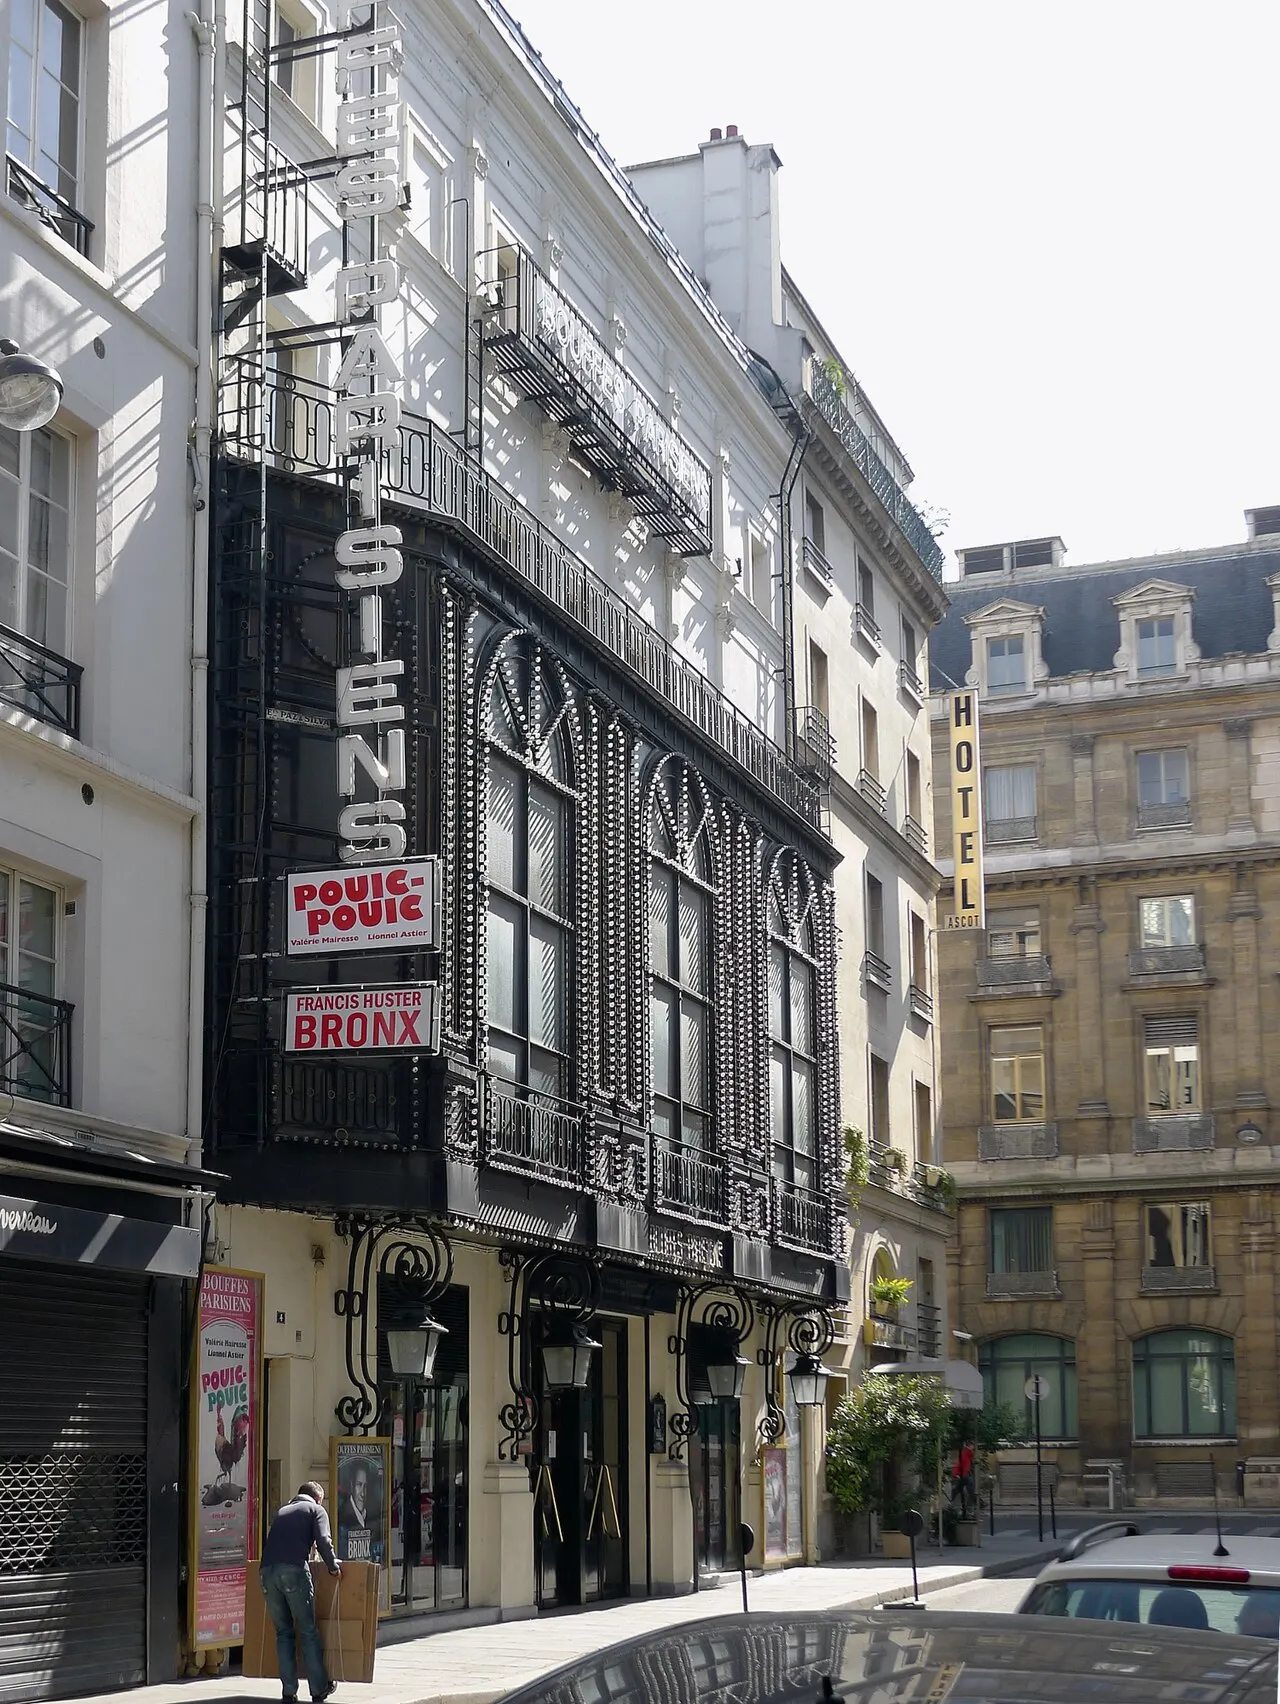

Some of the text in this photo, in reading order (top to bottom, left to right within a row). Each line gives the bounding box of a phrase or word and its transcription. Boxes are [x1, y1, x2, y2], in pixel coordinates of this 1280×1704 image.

[331, 259, 406, 861] PARISIENS
[280, 711, 298, 721] PAZ
[305, 716, 330, 726] SILVA
[954, 694, 976, 910] HOTEL
[294, 869, 425, 912] POUIC-
[307, 894, 424, 936] POUIC
[948, 914, 980, 928] ASCOT
[290, 929, 428, 946] Valérie Mairesse Lionnel Astier
[297, 991, 422, 1012] FRANCIS HUSTER
[294, 1009, 422, 1050] BRONX
[203, 1273, 249, 1295] BOUFFES
[200, 1292, 251, 1313] PARISIENS
[207, 1349, 245, 1359] Lionnel Astier
[224, 1339, 247, 1349] Mairesse
[202, 1364, 247, 1394] POUIC-
[207, 1383, 247, 1412] POUIC
[347, 1539, 371, 1559] BRONX
